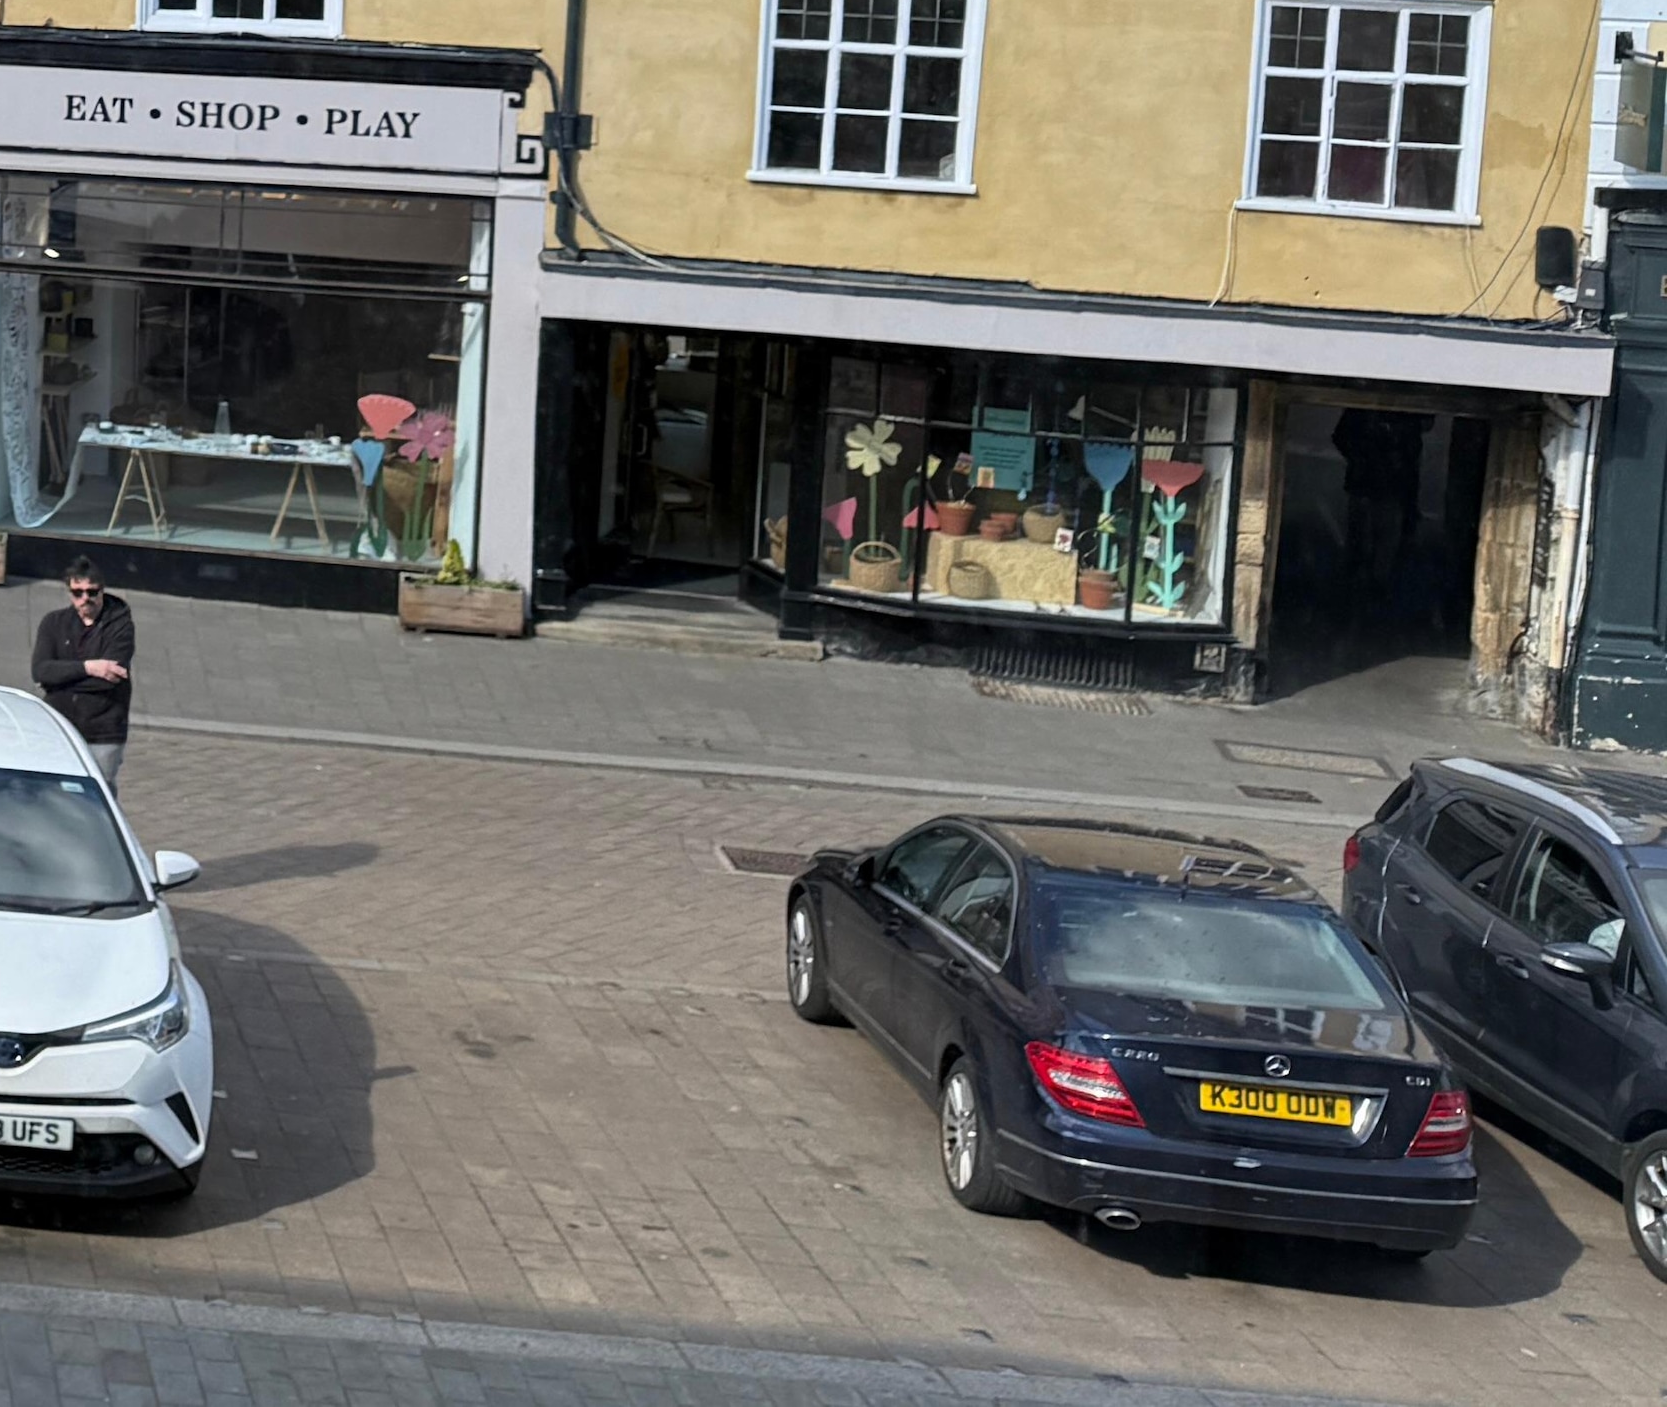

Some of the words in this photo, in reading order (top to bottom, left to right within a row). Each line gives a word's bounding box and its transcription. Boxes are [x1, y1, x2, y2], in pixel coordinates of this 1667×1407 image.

[64, 94, 134, 124] EAT
[175, 100, 281, 132] SHOP
[324, 108, 421, 139] PLAY
[1211, 1084, 1278, 1112] K300
[12, 1120, 60, 1144] UFS
